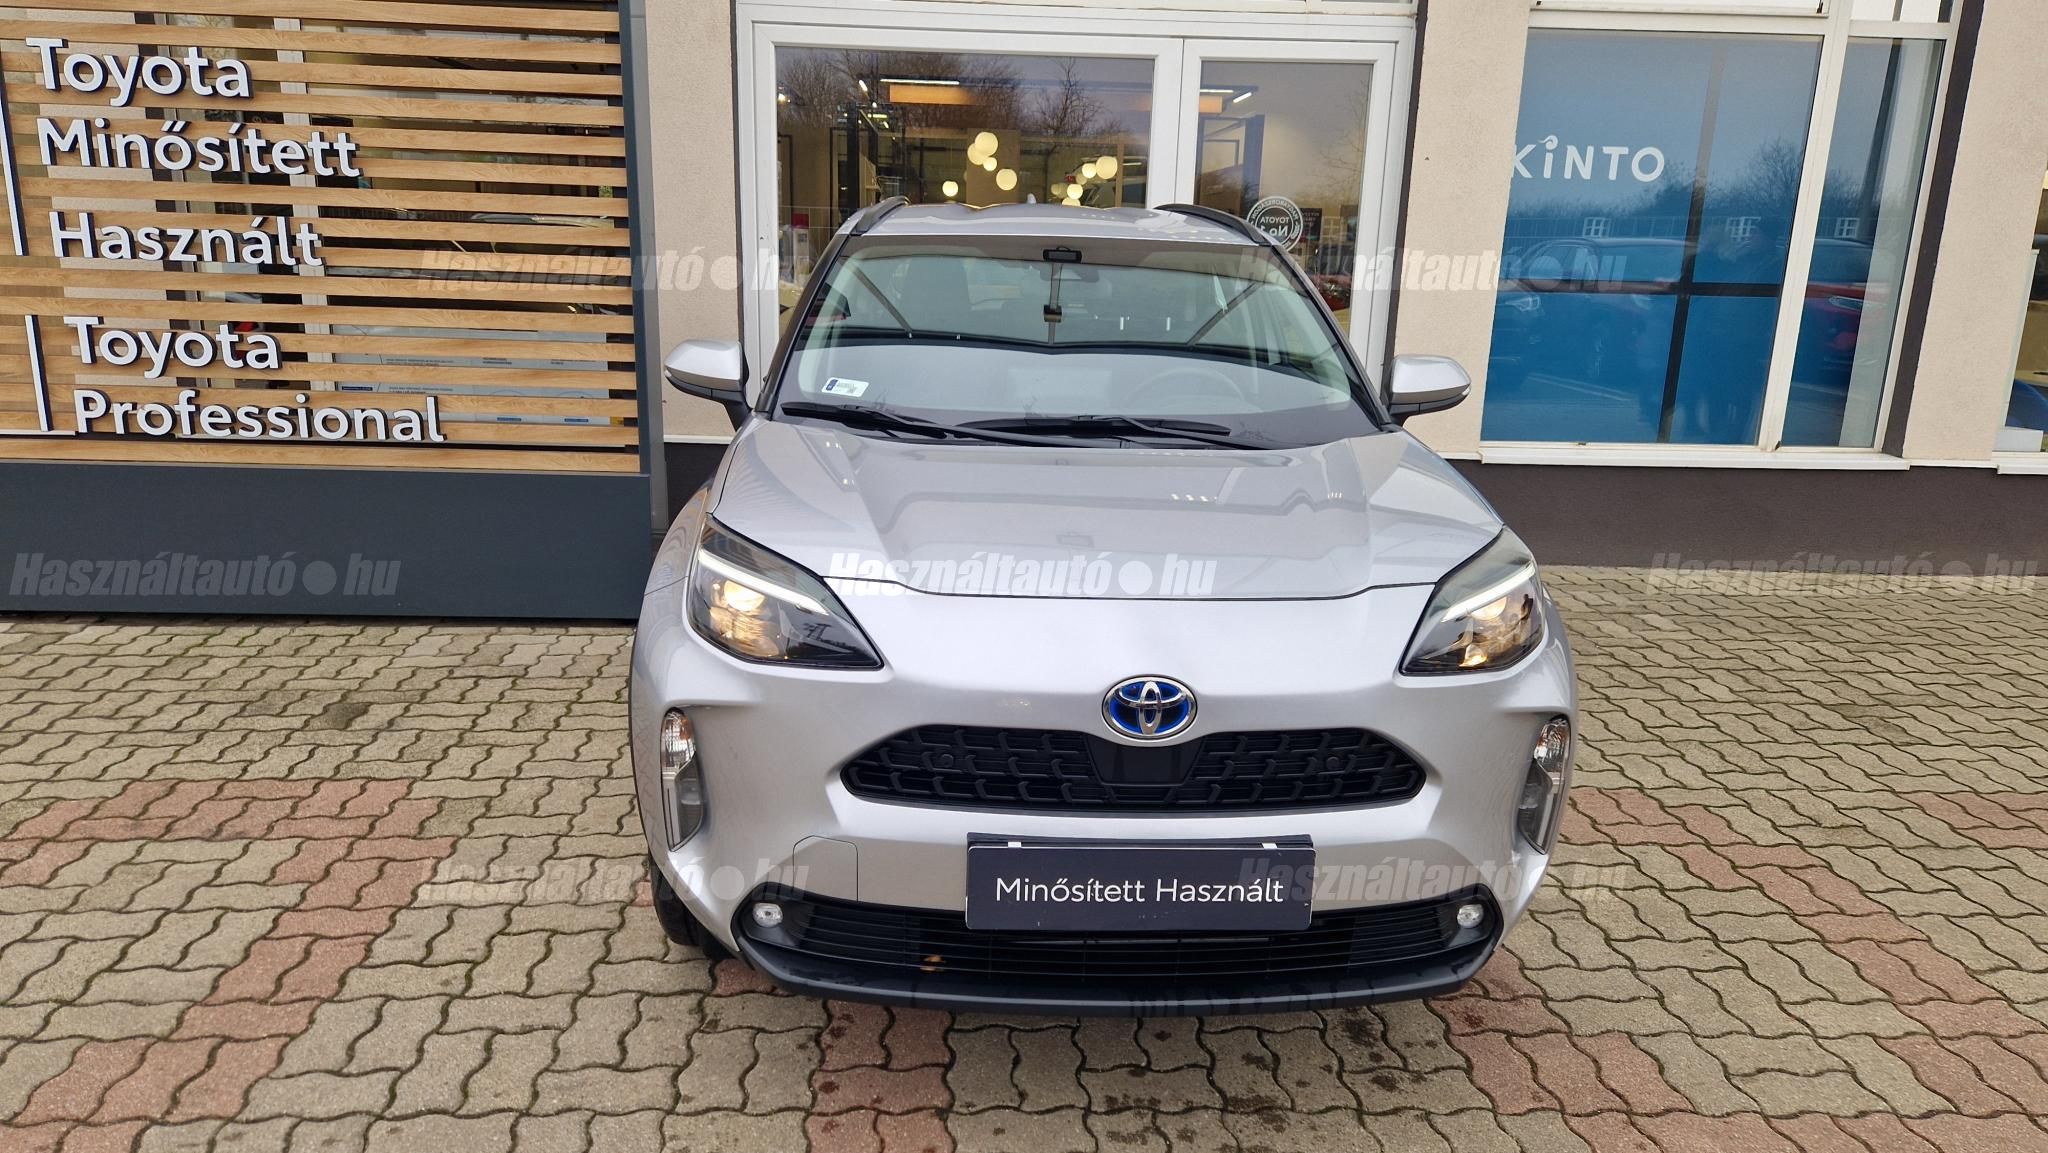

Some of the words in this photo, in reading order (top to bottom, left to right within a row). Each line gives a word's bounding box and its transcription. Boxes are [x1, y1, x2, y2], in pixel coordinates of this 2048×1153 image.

[25, 37, 252, 107] Toyota
[36, 117, 362, 177] Minősített
[49, 211, 325, 266] Használt
[64, 316, 282, 379] Toyota
[74, 389, 446, 442] Professional
[996, 878, 1146, 902] Minősített
[1156, 878, 1284, 902] Használt
